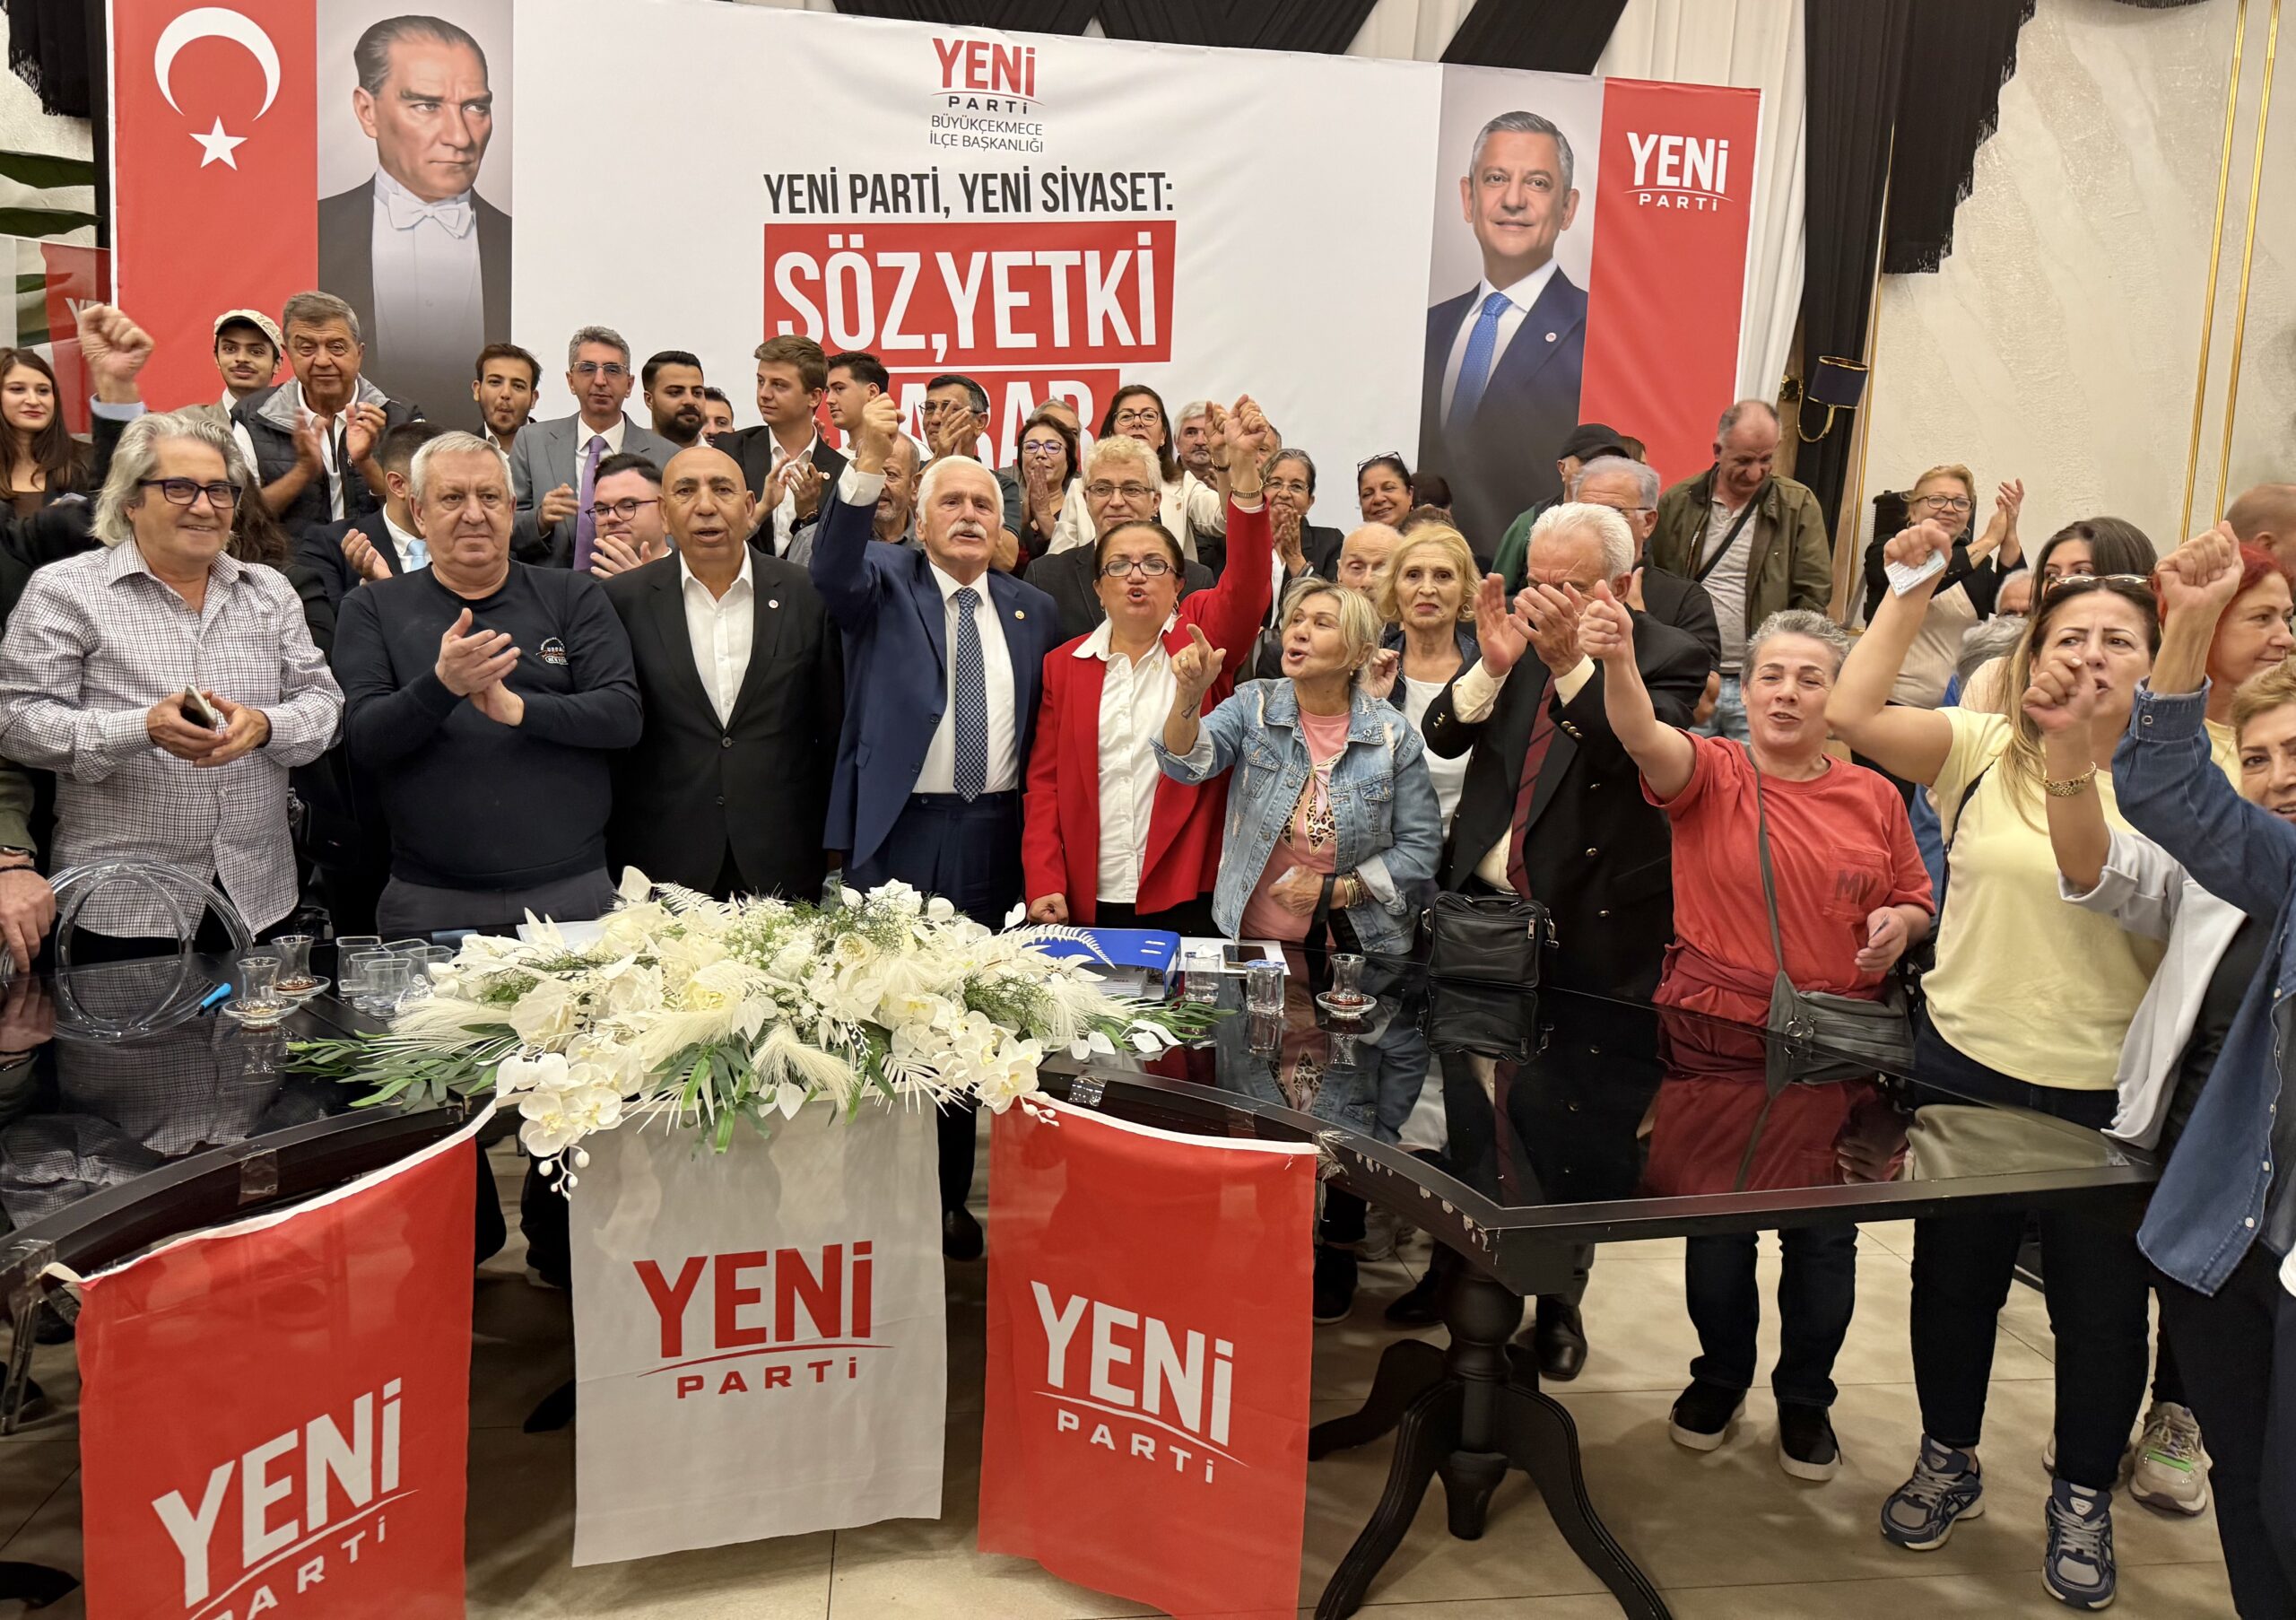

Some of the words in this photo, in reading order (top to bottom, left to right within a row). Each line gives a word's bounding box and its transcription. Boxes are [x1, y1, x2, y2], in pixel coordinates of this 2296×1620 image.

[932, 113, 1043, 135] BÜYÜKÇEKMECE
[930, 130, 958, 148] İLÇE
[962, 135, 1043, 152] BAŞKANLIĞI
[763, 167, 839, 214] YENİ
[848, 166, 952, 219] PARTİ,
[958, 165, 1032, 213] YENİ
[1041, 165, 1174, 213] SİYASET:
